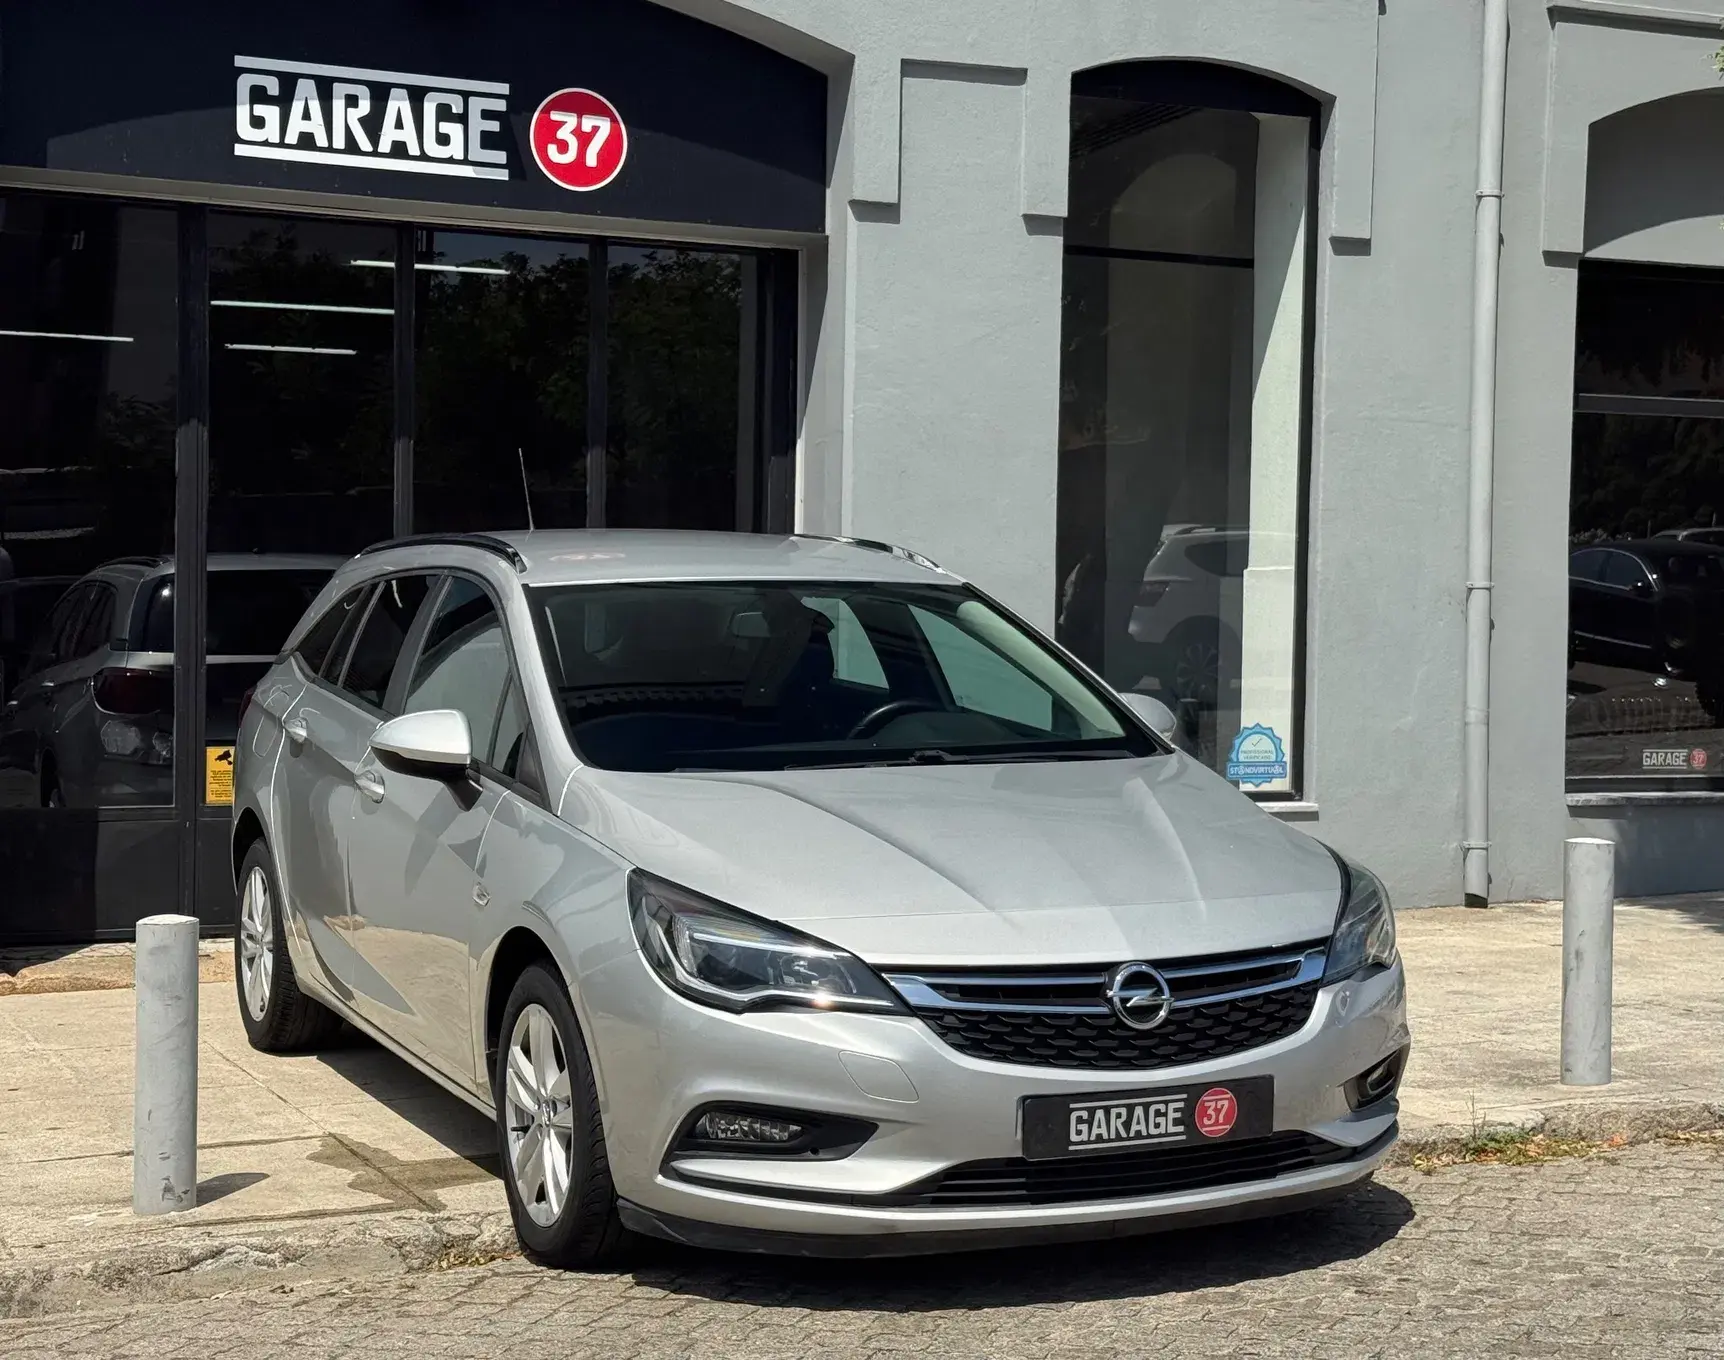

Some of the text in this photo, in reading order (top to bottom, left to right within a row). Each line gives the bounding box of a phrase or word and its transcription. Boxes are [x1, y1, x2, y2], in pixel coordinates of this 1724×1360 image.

[235, 72, 611, 168] GARAGE 37
[1642, 752, 1688, 766] GARAGE
[1069, 1100, 1230, 1143] GARAGE 37
